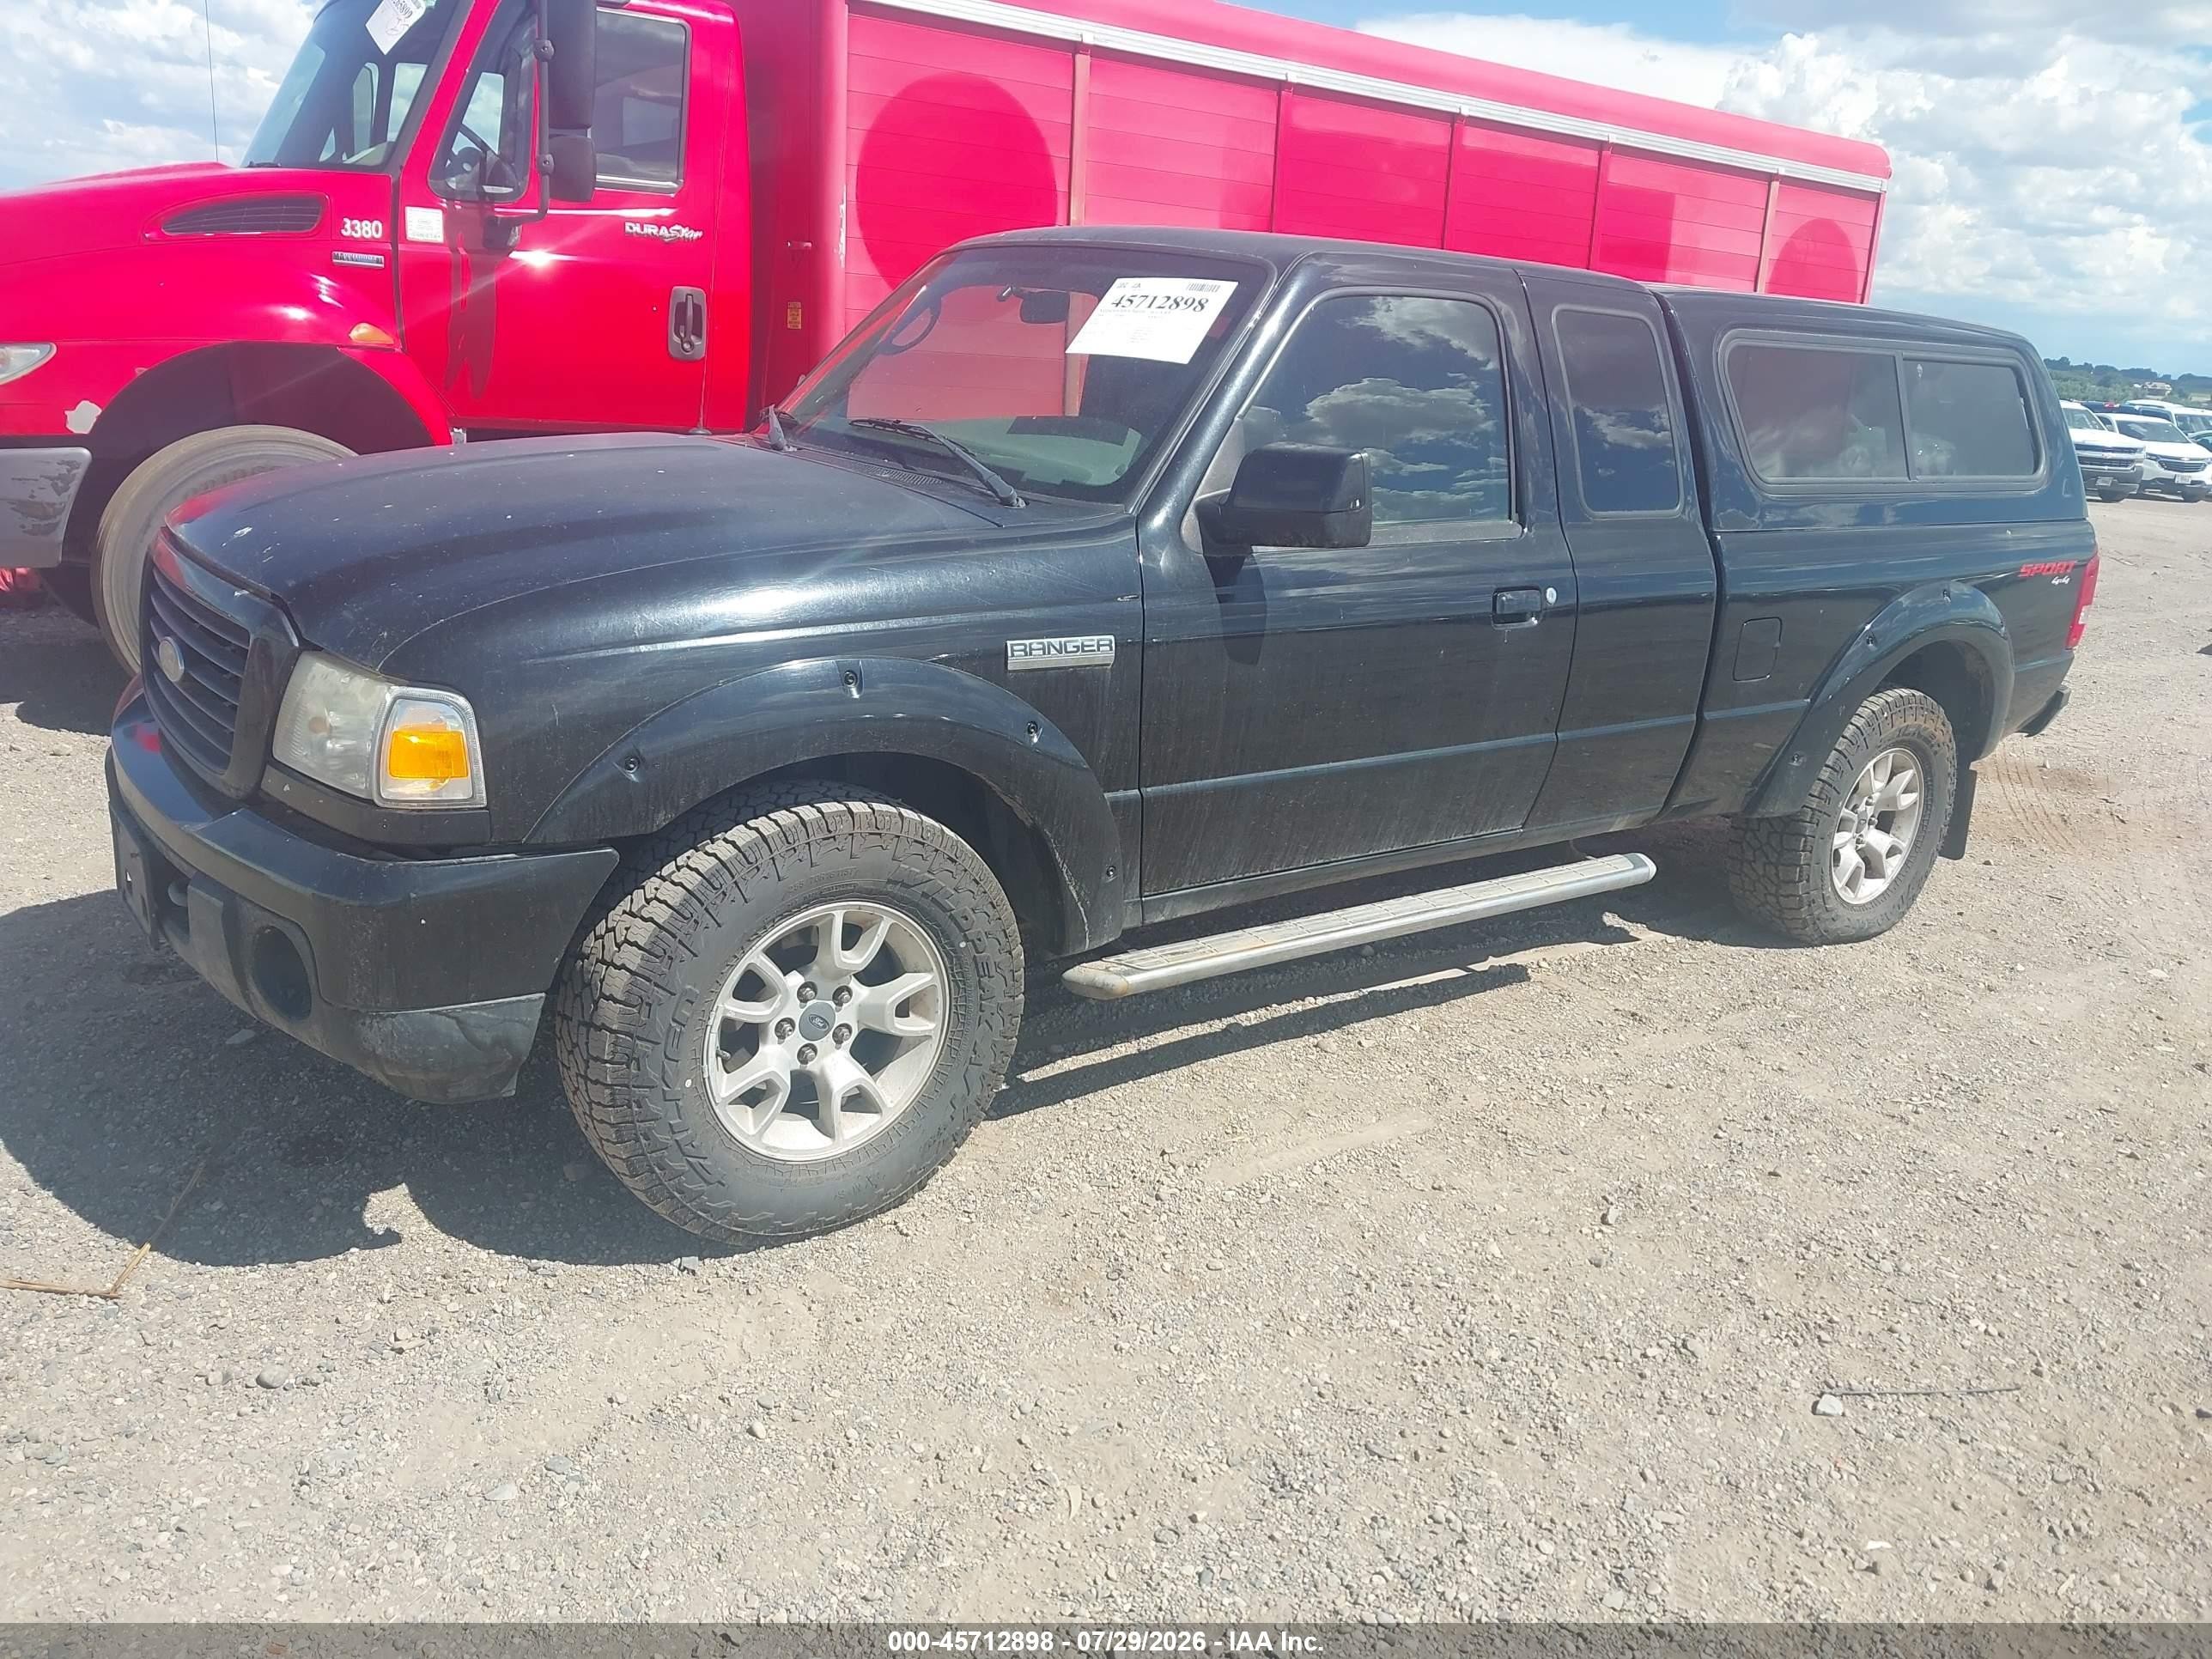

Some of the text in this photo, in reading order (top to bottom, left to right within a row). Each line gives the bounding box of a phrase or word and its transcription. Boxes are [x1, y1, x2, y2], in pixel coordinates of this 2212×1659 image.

[341, 217, 383, 239] 3380
[1111, 294, 1211, 313] 45712898
[2018, 561, 2075, 577] SPORT
[1009, 637, 1114, 658] RANGER
[884, 862, 997, 1033] WILDPEAK
